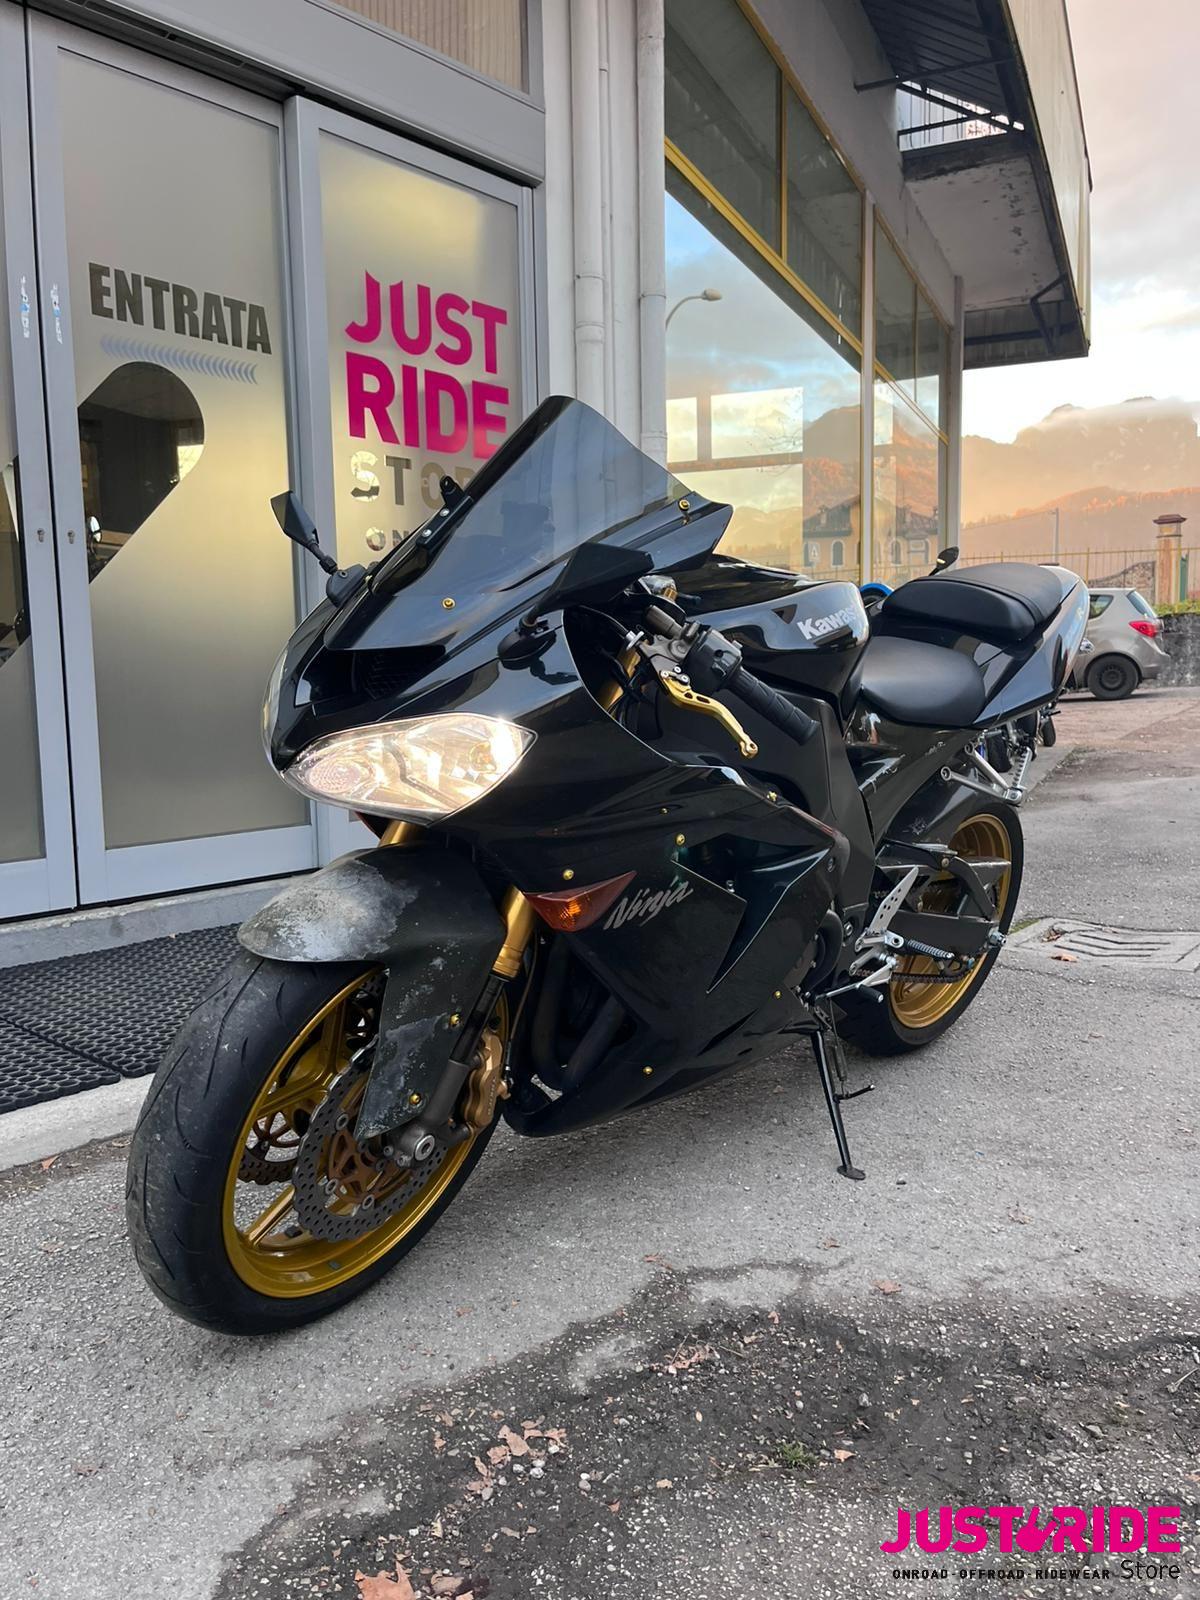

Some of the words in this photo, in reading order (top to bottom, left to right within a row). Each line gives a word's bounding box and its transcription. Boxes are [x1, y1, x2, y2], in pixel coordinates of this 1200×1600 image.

[88, 262, 272, 355] ENTRATA
[345, 269, 508, 375] JUST
[345, 350, 509, 460] RIDE
[603, 875, 694, 930] Ninja
